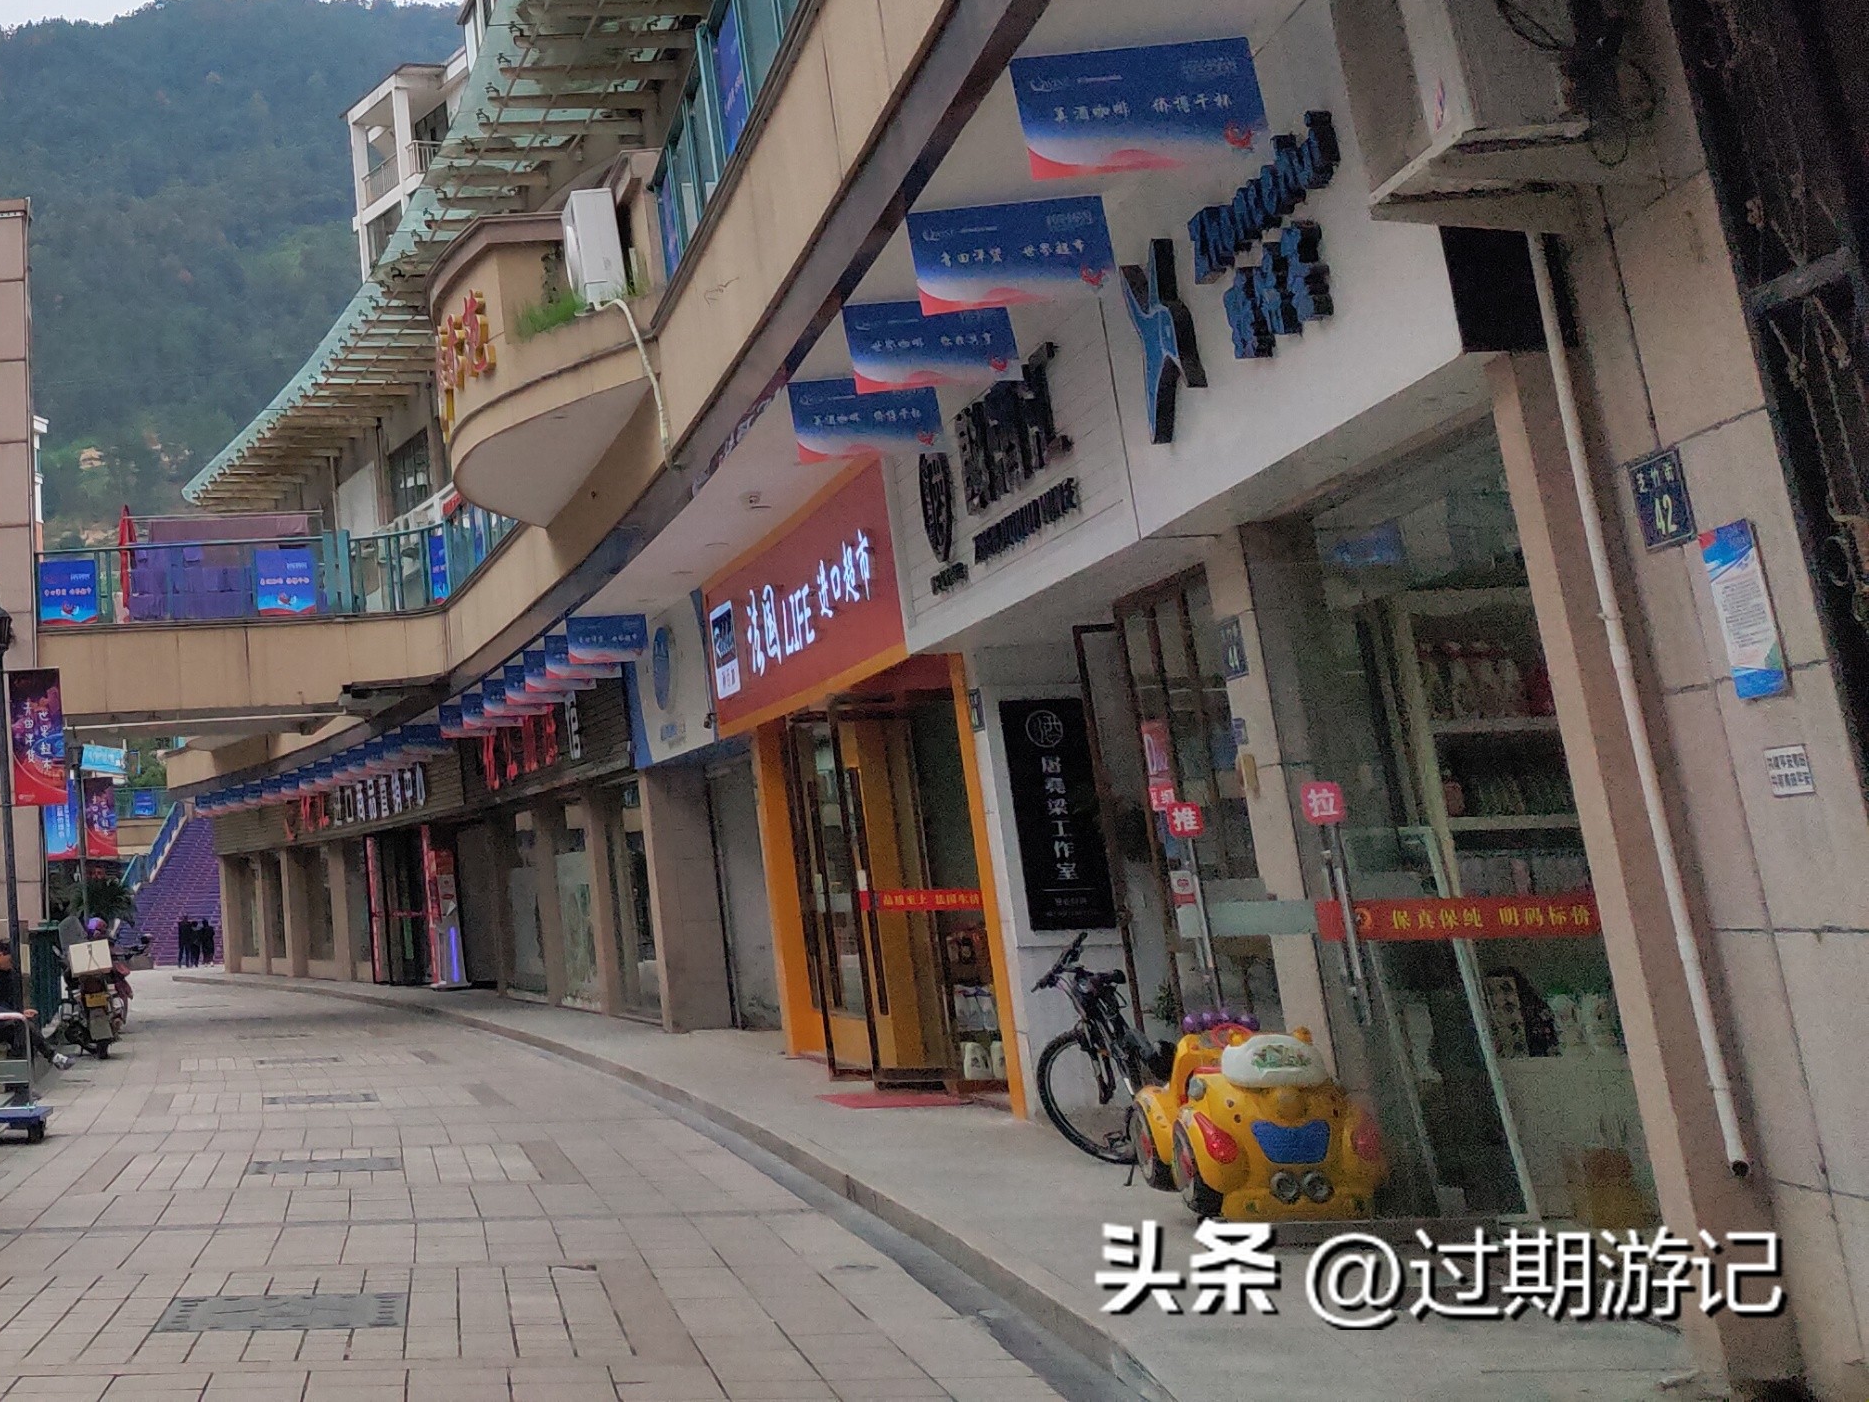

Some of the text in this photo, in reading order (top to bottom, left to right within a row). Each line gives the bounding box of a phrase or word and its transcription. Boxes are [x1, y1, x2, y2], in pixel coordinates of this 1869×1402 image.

[1654, 494, 1677, 535] 42
[23, 699, 35, 762] 青田洋货
[38, 710, 53, 770] 世界超市
[1172, 807, 1200, 832] 推
[1308, 788, 1339, 817] 拉
[1391, 902, 1590, 930] 保真保纯 明码标价
